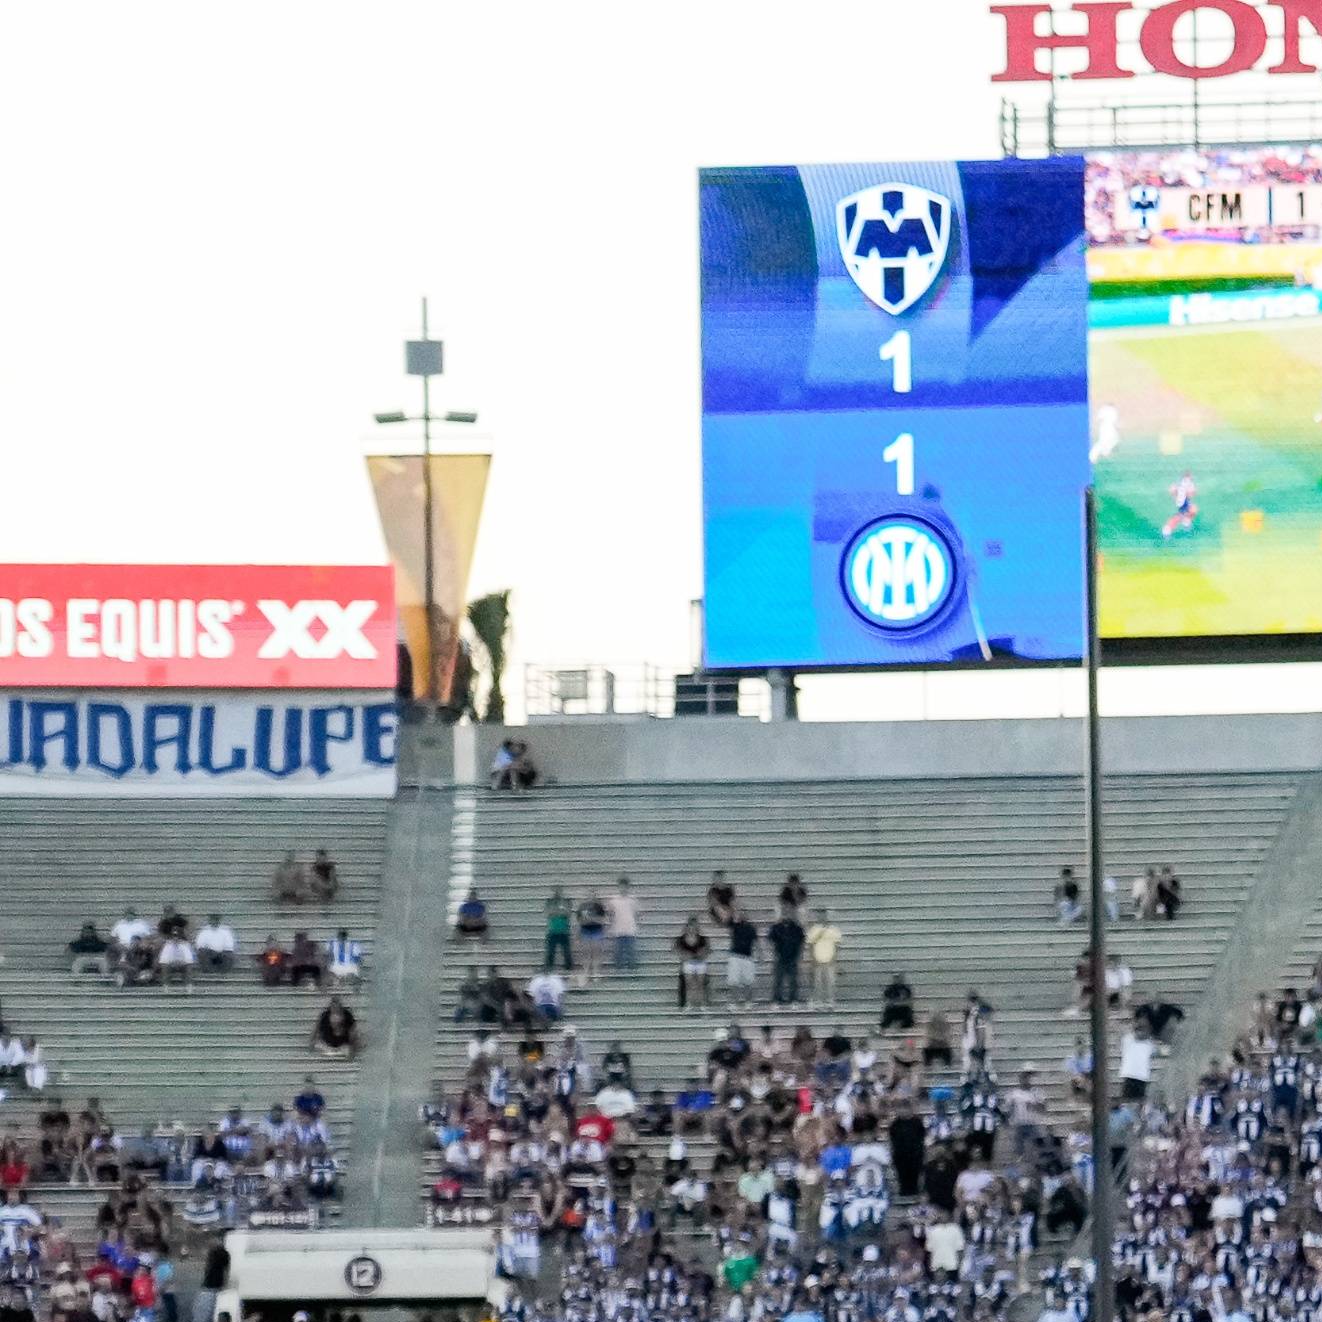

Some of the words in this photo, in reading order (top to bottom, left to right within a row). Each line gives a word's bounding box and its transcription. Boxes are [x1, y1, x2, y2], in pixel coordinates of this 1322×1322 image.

[1187, 193, 1243, 221] CFM
[879, 330, 912, 393] 1
[883, 433, 914, 495] 1
[66, 598, 236, 662] EQUIS
[257, 599, 379, 660] XX
